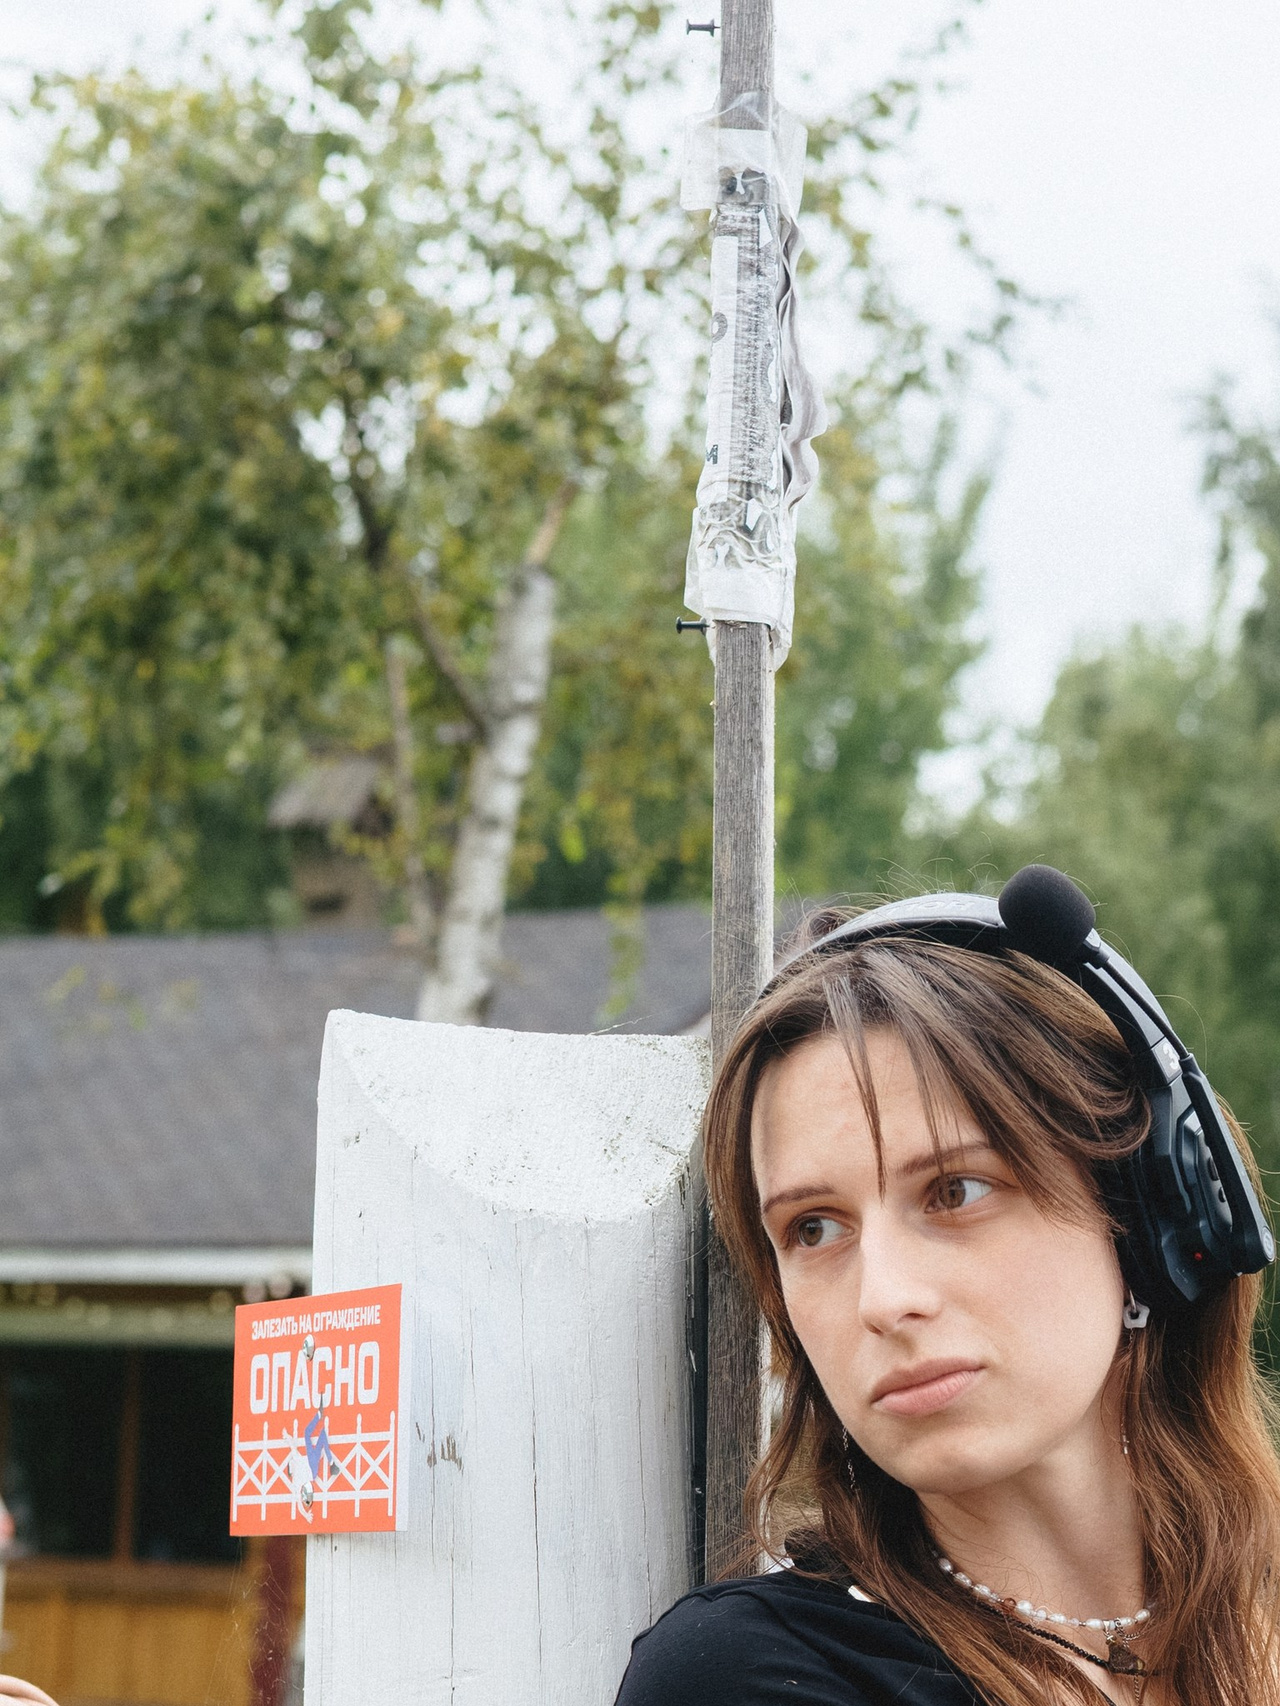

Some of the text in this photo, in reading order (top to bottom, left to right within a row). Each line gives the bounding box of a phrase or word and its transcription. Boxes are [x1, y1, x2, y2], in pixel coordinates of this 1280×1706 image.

[1162, 1042, 1180, 1070] 3
[251, 1304, 381, 1341] ЗАЛЕЗАТЬ НА ОГРАЖДЕНИЕ
[250, 1341, 380, 1415] ОПАСНО
